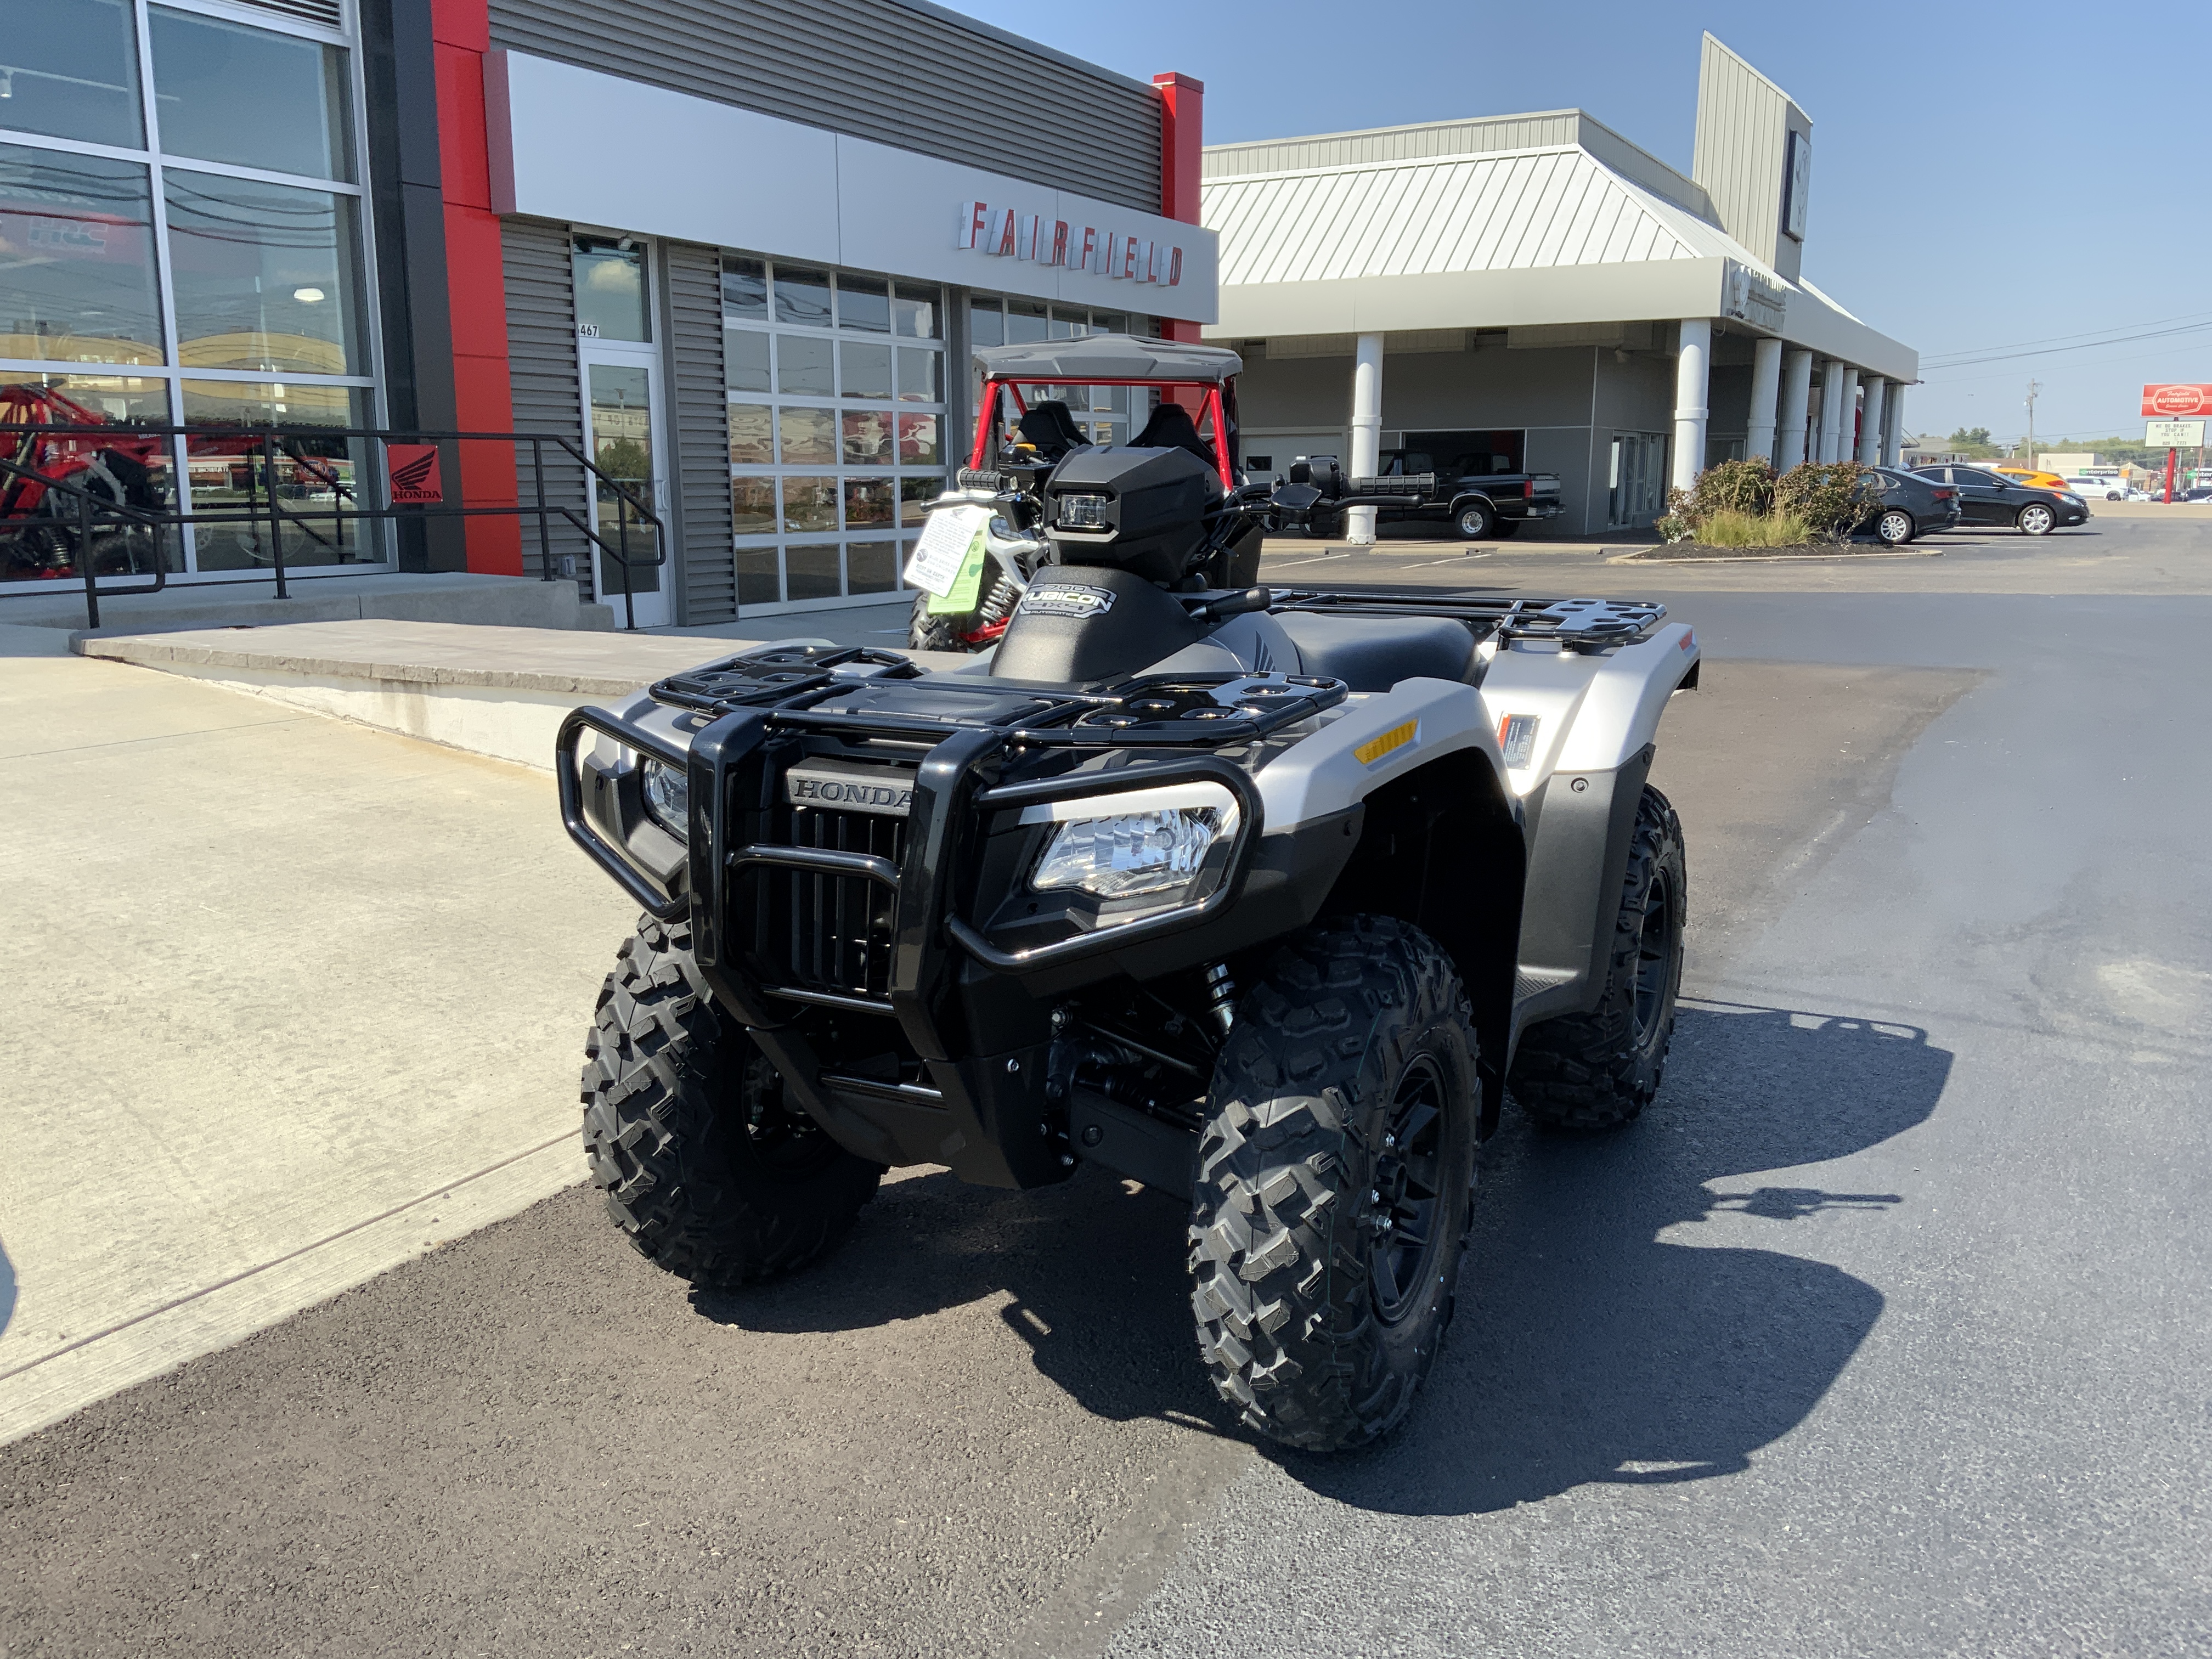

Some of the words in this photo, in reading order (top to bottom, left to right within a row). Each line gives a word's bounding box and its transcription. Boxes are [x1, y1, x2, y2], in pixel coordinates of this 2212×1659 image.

[960, 201, 1183, 286] FAIRFIELD
[578, 324, 598, 336] 467
[393, 490, 441, 499] HONDA
[1046, 583, 1087, 592] 700
[794, 779, 913, 808] HONDA
